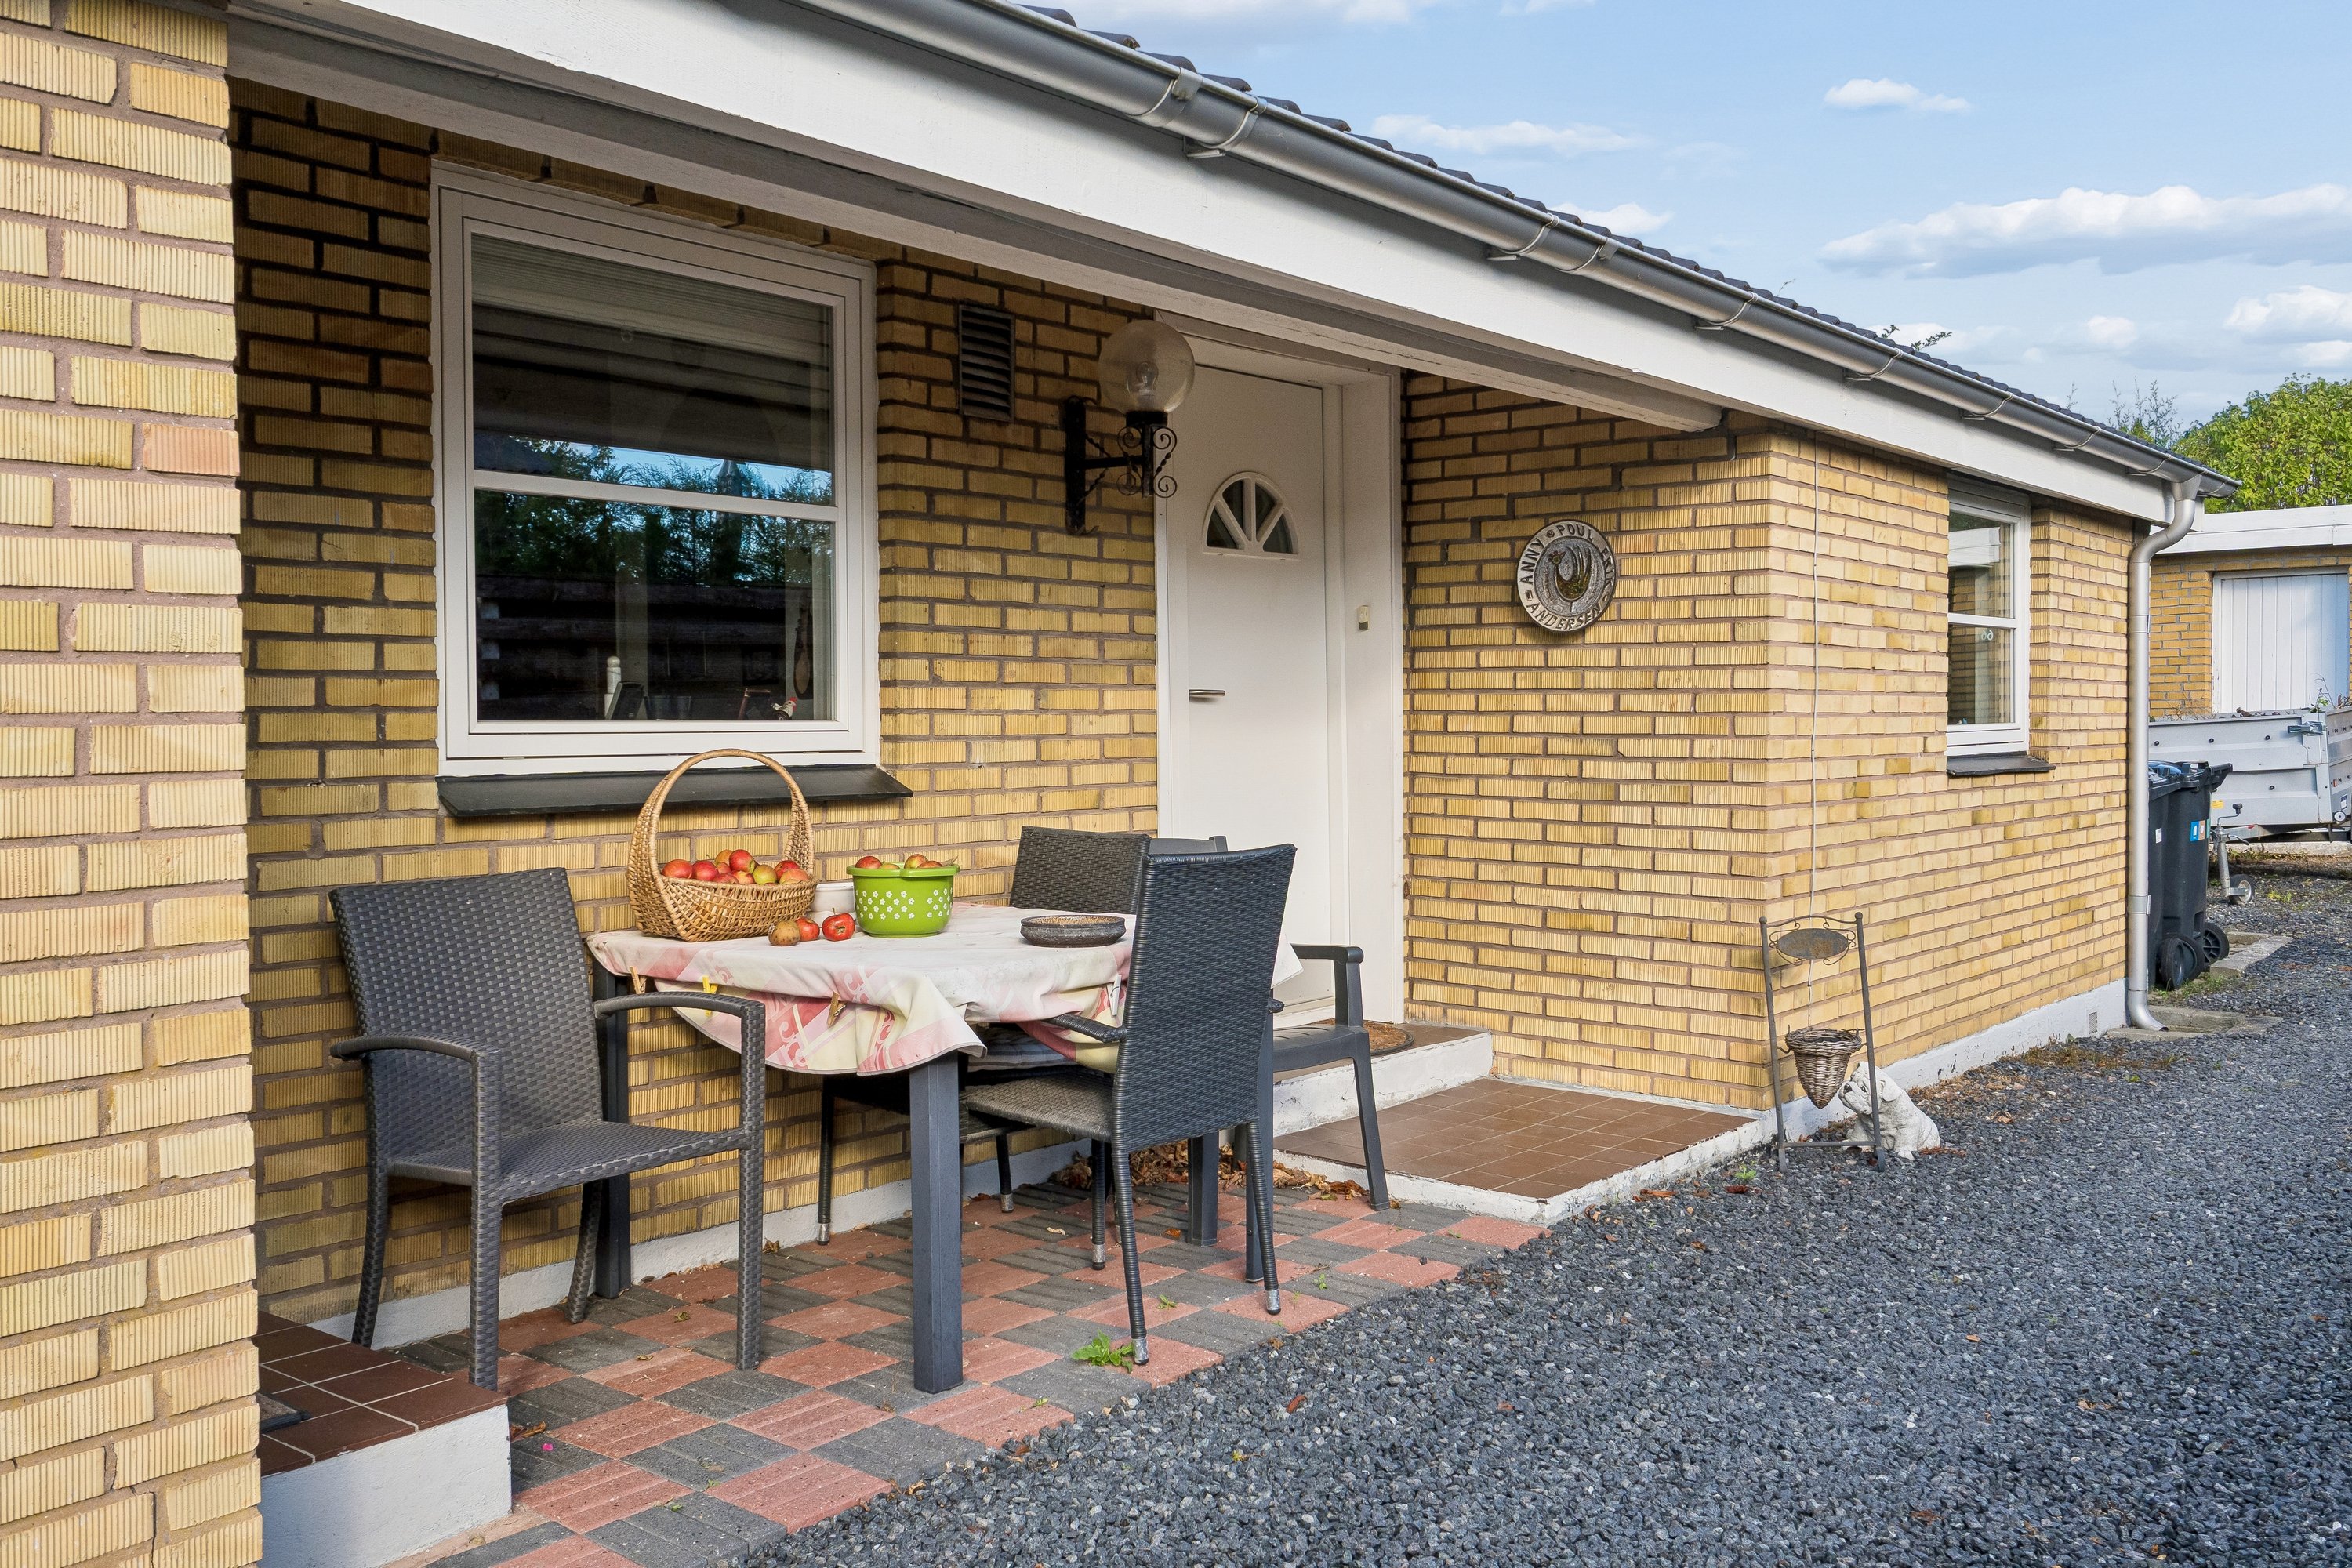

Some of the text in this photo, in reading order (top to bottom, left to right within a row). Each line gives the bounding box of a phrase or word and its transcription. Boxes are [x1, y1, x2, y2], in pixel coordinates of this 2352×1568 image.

[1519, 537, 1544, 586] ANNY
[1556, 523, 1614, 589] POUL ERIK
[1526, 601, 1600, 630] ANDERSEN
